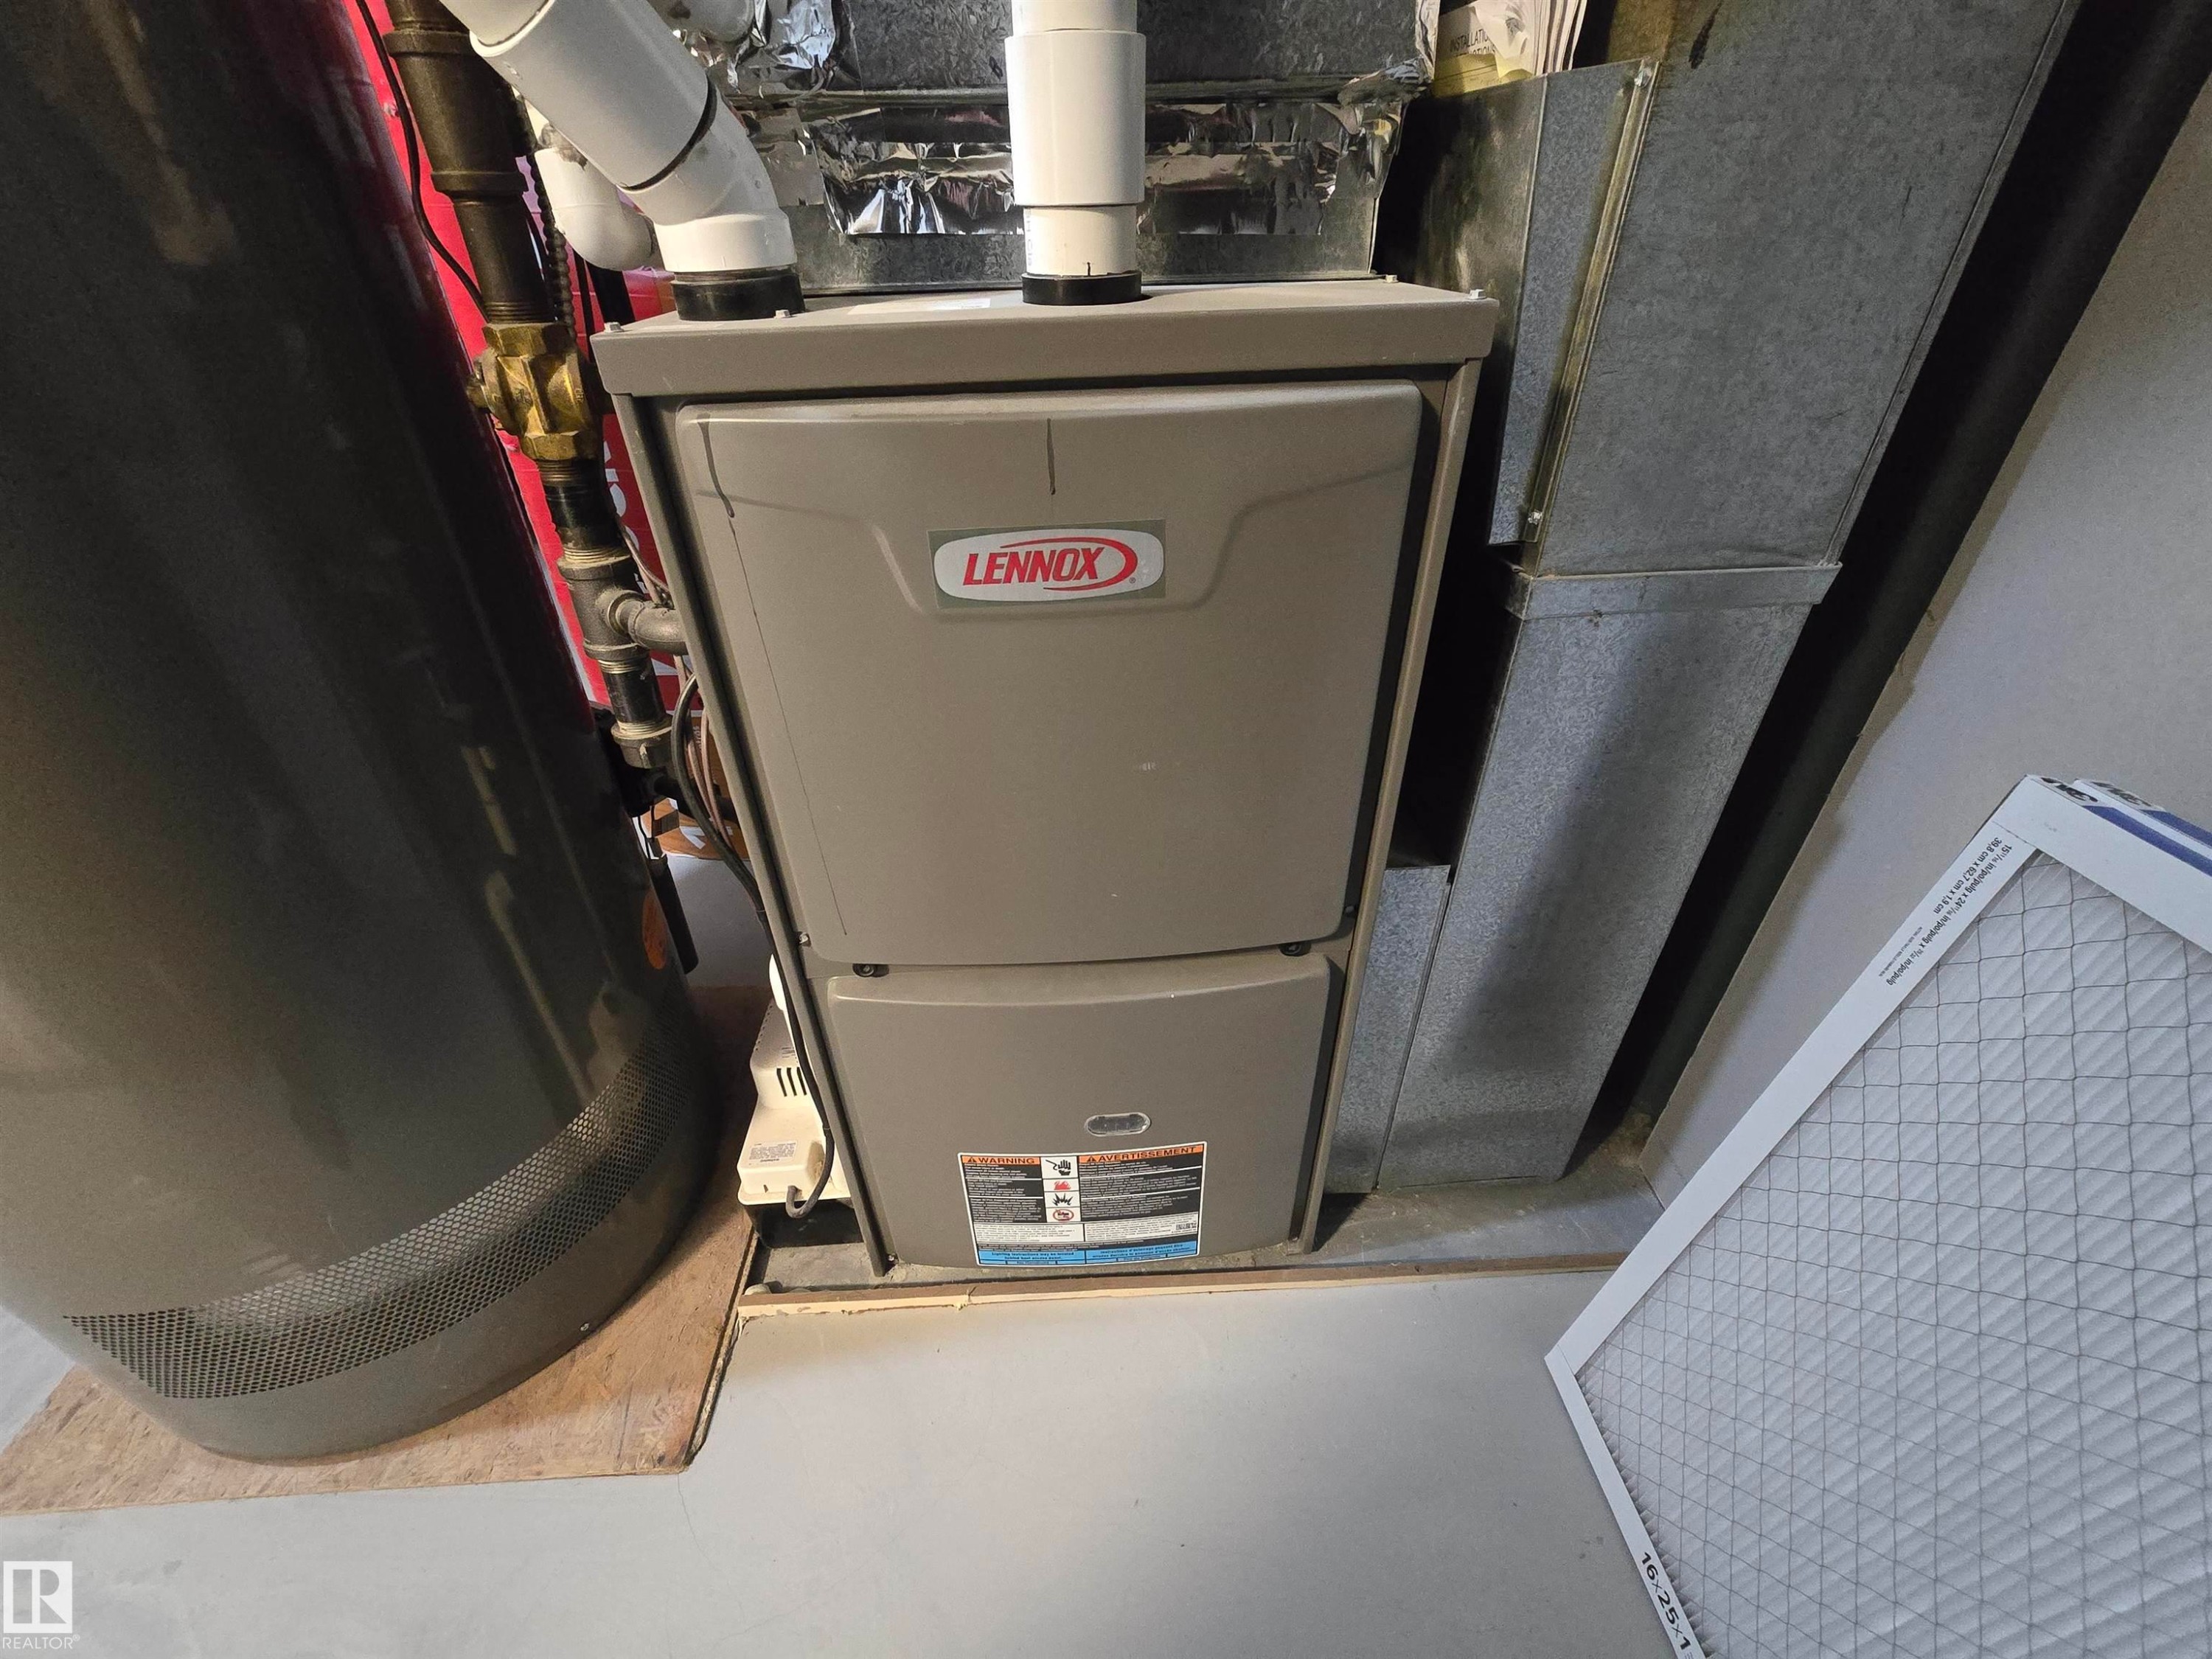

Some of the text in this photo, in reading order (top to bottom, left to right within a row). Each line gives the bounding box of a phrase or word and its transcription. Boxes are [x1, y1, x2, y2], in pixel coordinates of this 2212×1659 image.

[1450, 28, 1489, 51] INSTALLATIO
[962, 546, 1105, 586] LENNOX
[1985, 835, 2002, 854] 39,8
[1977, 850, 1989, 863] cm
[1961, 864, 1976, 881] 62,7
[1952, 878, 1964, 891] cm
[1940, 892, 1952, 905] 1,9
[1933, 902, 1944, 914] cm
[1099, 1147, 1196, 1161] AVERTISSEMENT
